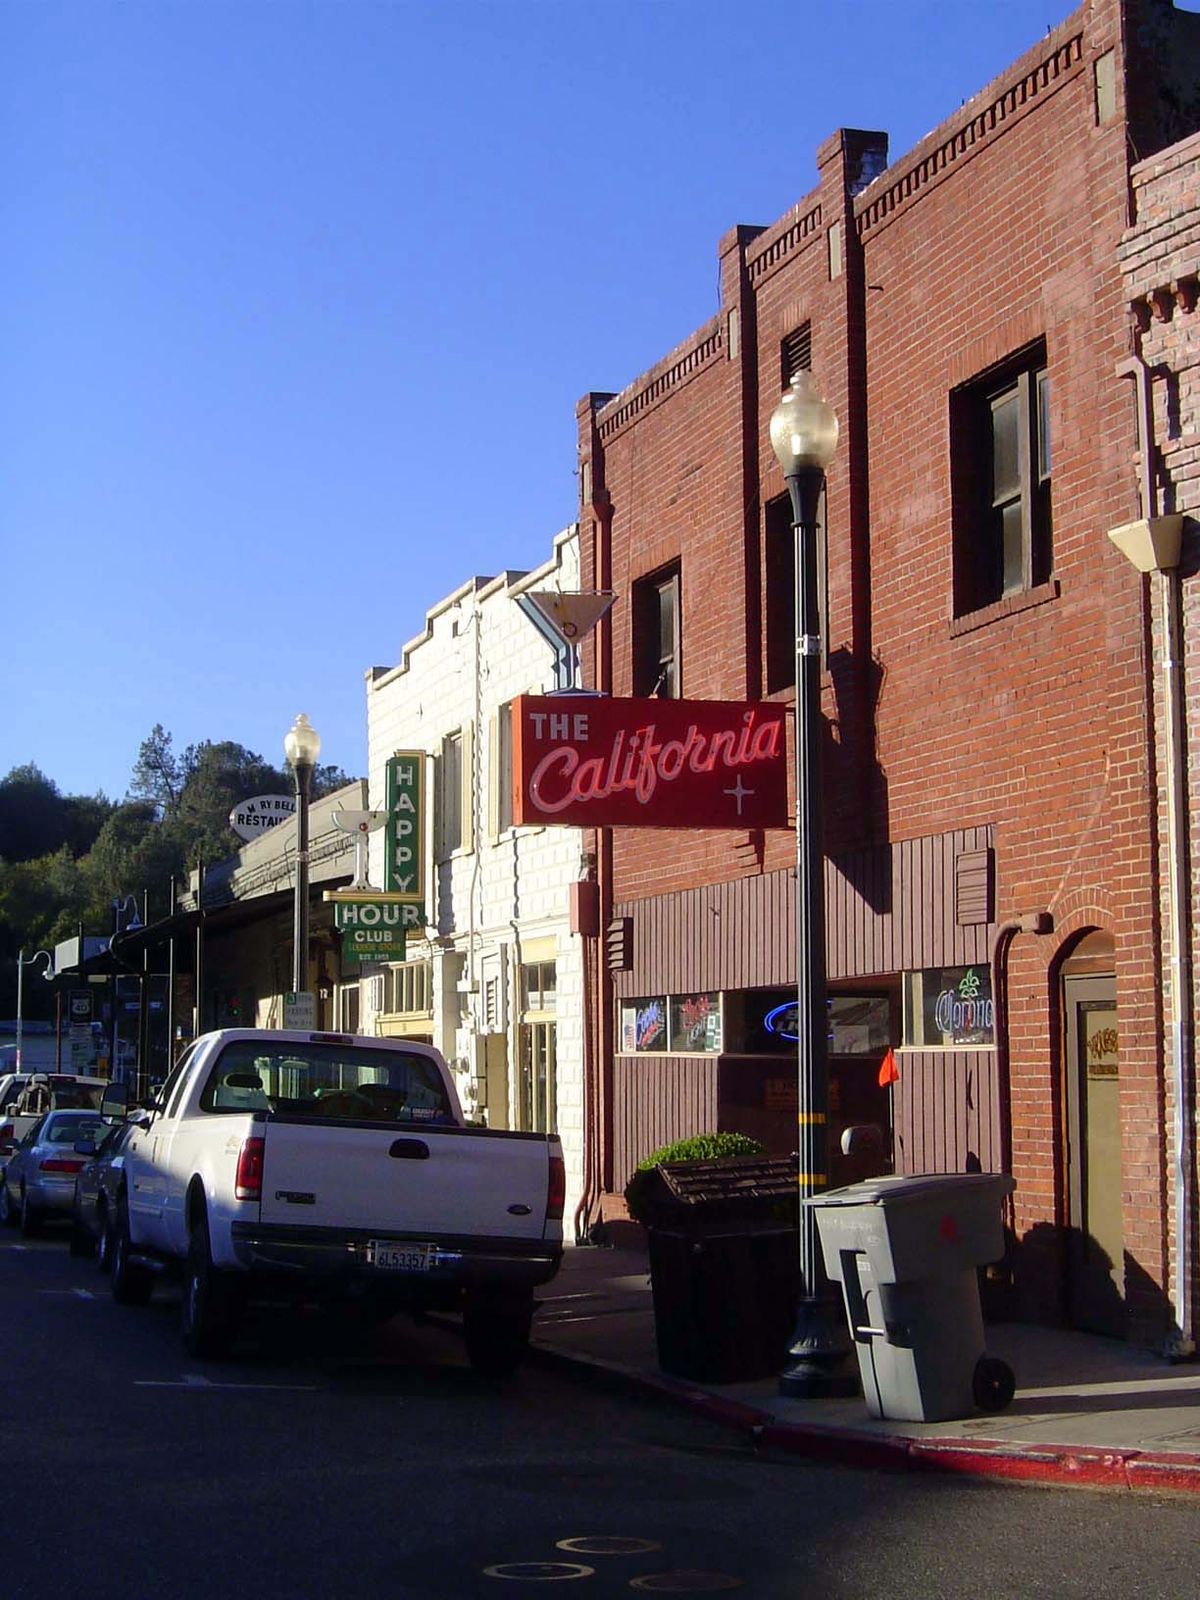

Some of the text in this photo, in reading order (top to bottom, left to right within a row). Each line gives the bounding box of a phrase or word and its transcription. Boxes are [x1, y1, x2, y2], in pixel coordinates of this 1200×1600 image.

[529, 713, 588, 741] THE
[529, 710, 781, 813] California
[394, 765, 415, 893] HAPPY
[342, 904, 420, 925] HOUR
[354, 930, 393, 943] CLUB
[935, 989, 994, 1033] Corona
